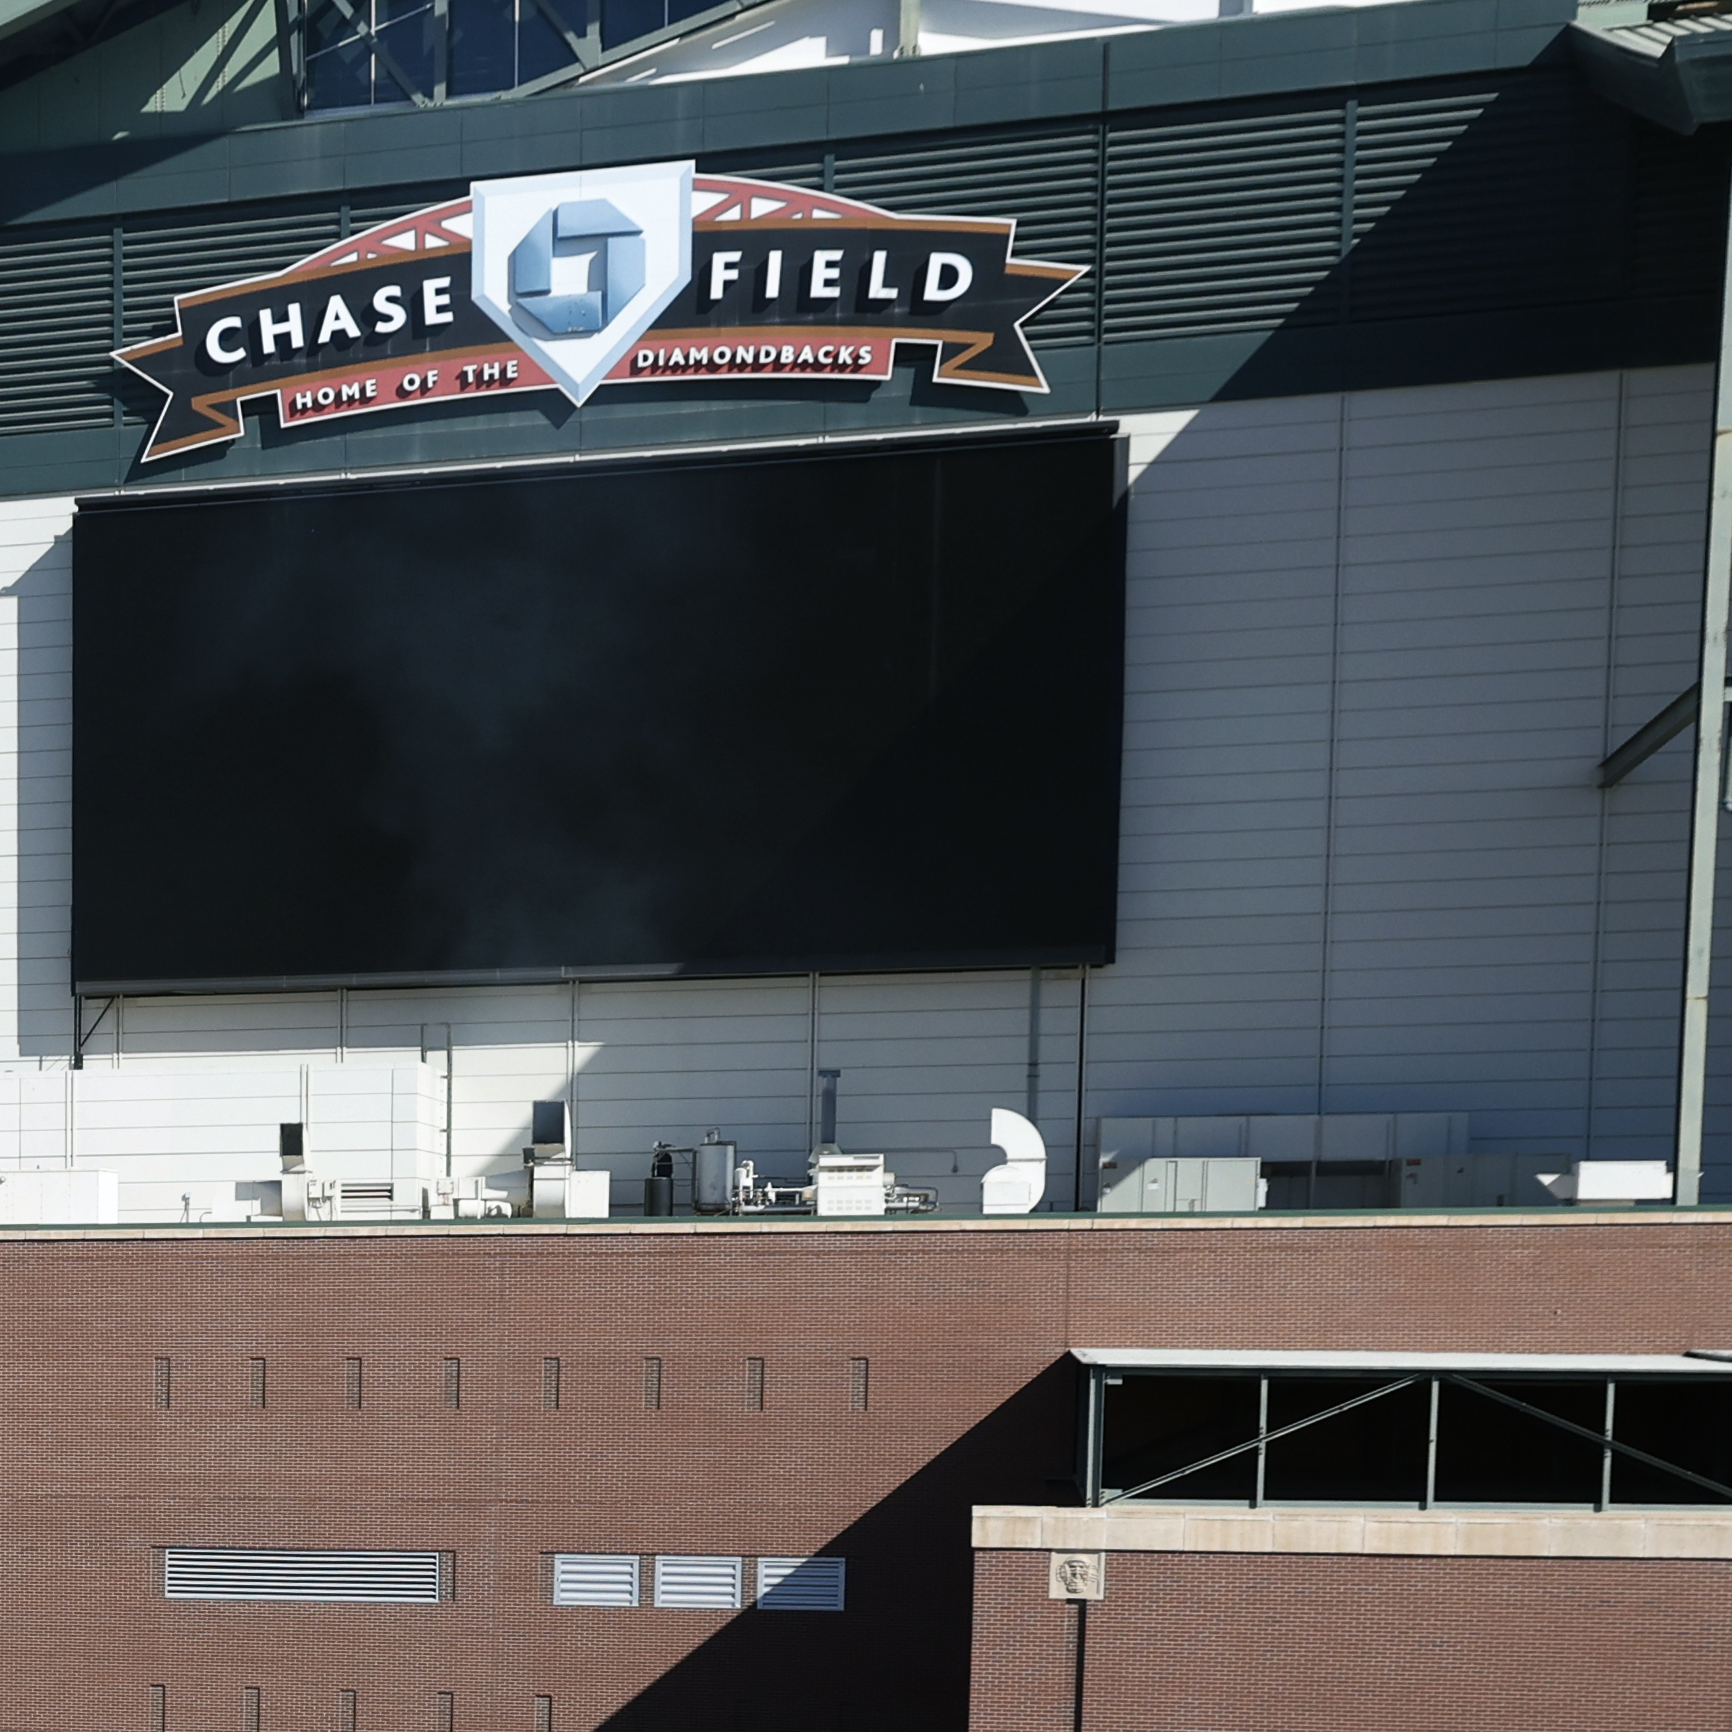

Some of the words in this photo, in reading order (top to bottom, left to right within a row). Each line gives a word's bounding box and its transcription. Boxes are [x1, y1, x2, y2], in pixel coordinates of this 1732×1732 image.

[205, 275, 455, 365] CHASE
[709, 248, 975, 302] FIELD
[294, 378, 378, 414] HOME
[402, 370, 440, 393] OF
[461, 359, 521, 385] THE
[636, 345, 874, 370] DIAMONDBACKS
